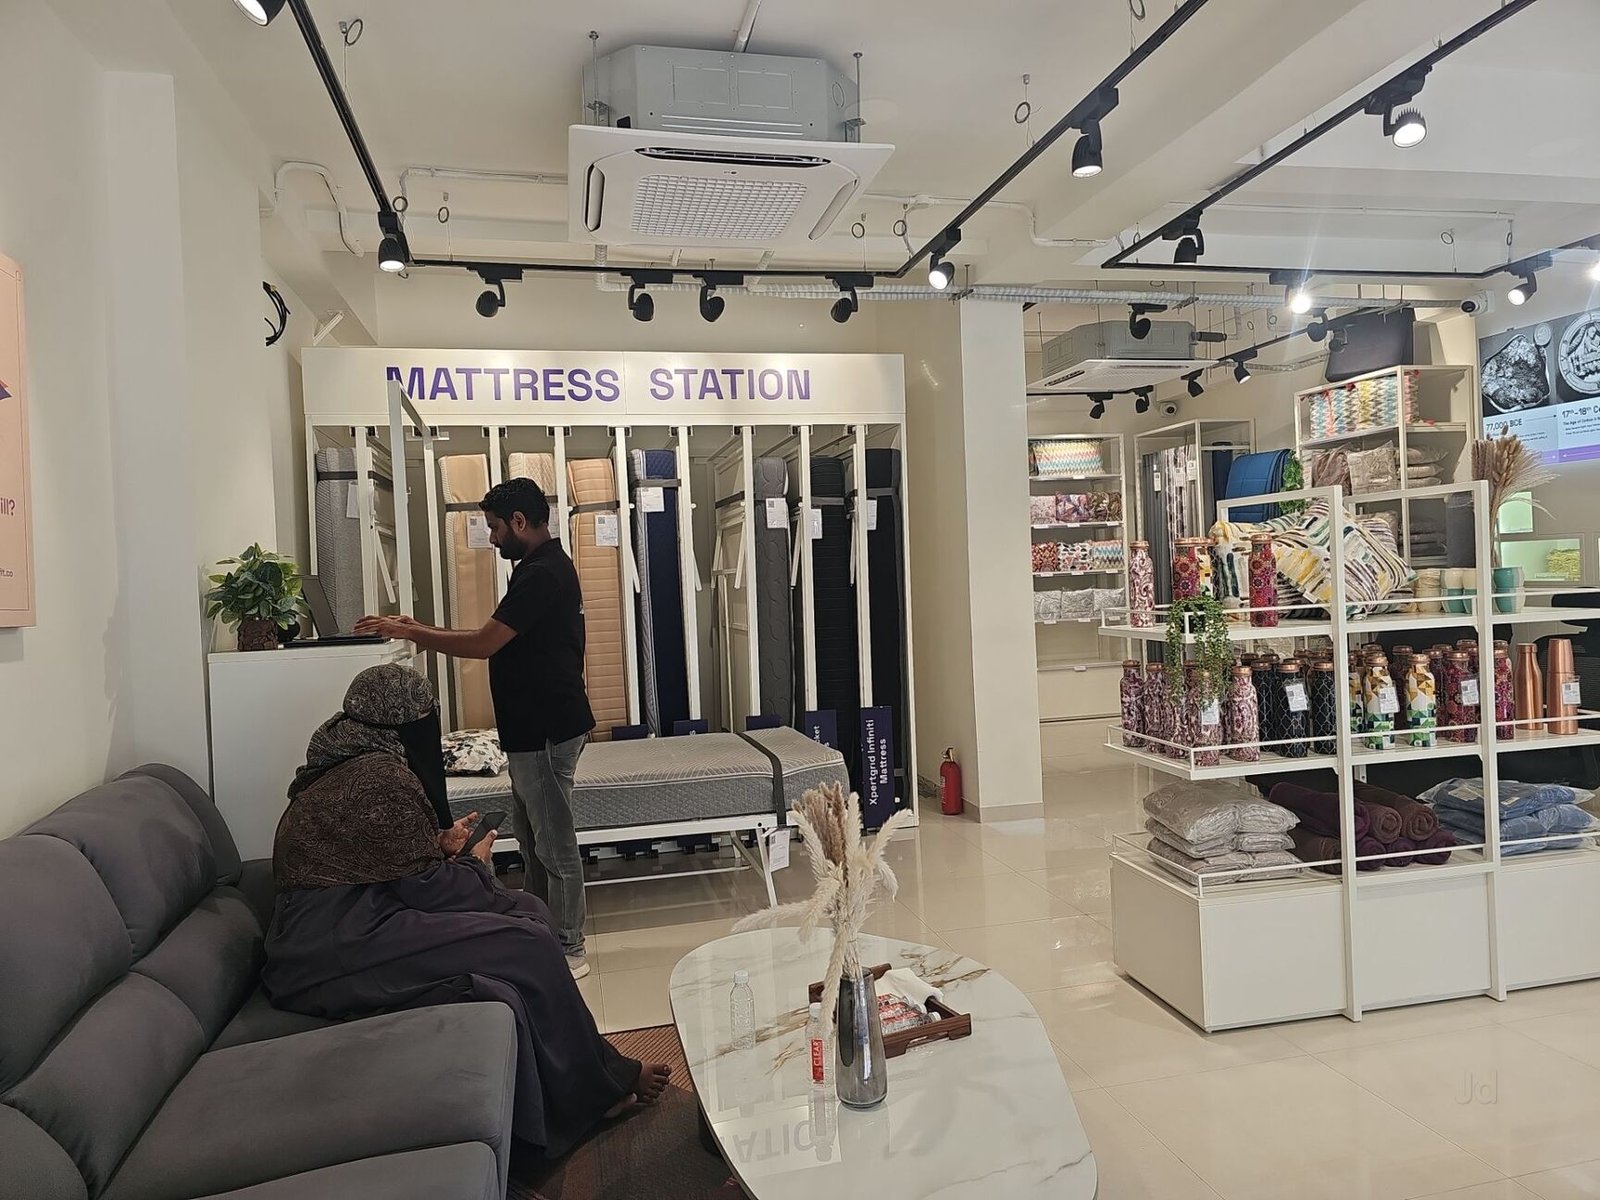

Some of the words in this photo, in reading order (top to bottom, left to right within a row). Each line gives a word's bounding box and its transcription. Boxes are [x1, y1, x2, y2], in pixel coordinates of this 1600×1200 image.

[385, 366, 620, 402] MATTRESS
[649, 368, 811, 401] STATION
[1509, 418, 1522, 427] BCE
[866, 719, 876, 754] Infiniti
[880, 738, 888, 784] Mattress
[868, 755, 879, 805] Xpertgrid
